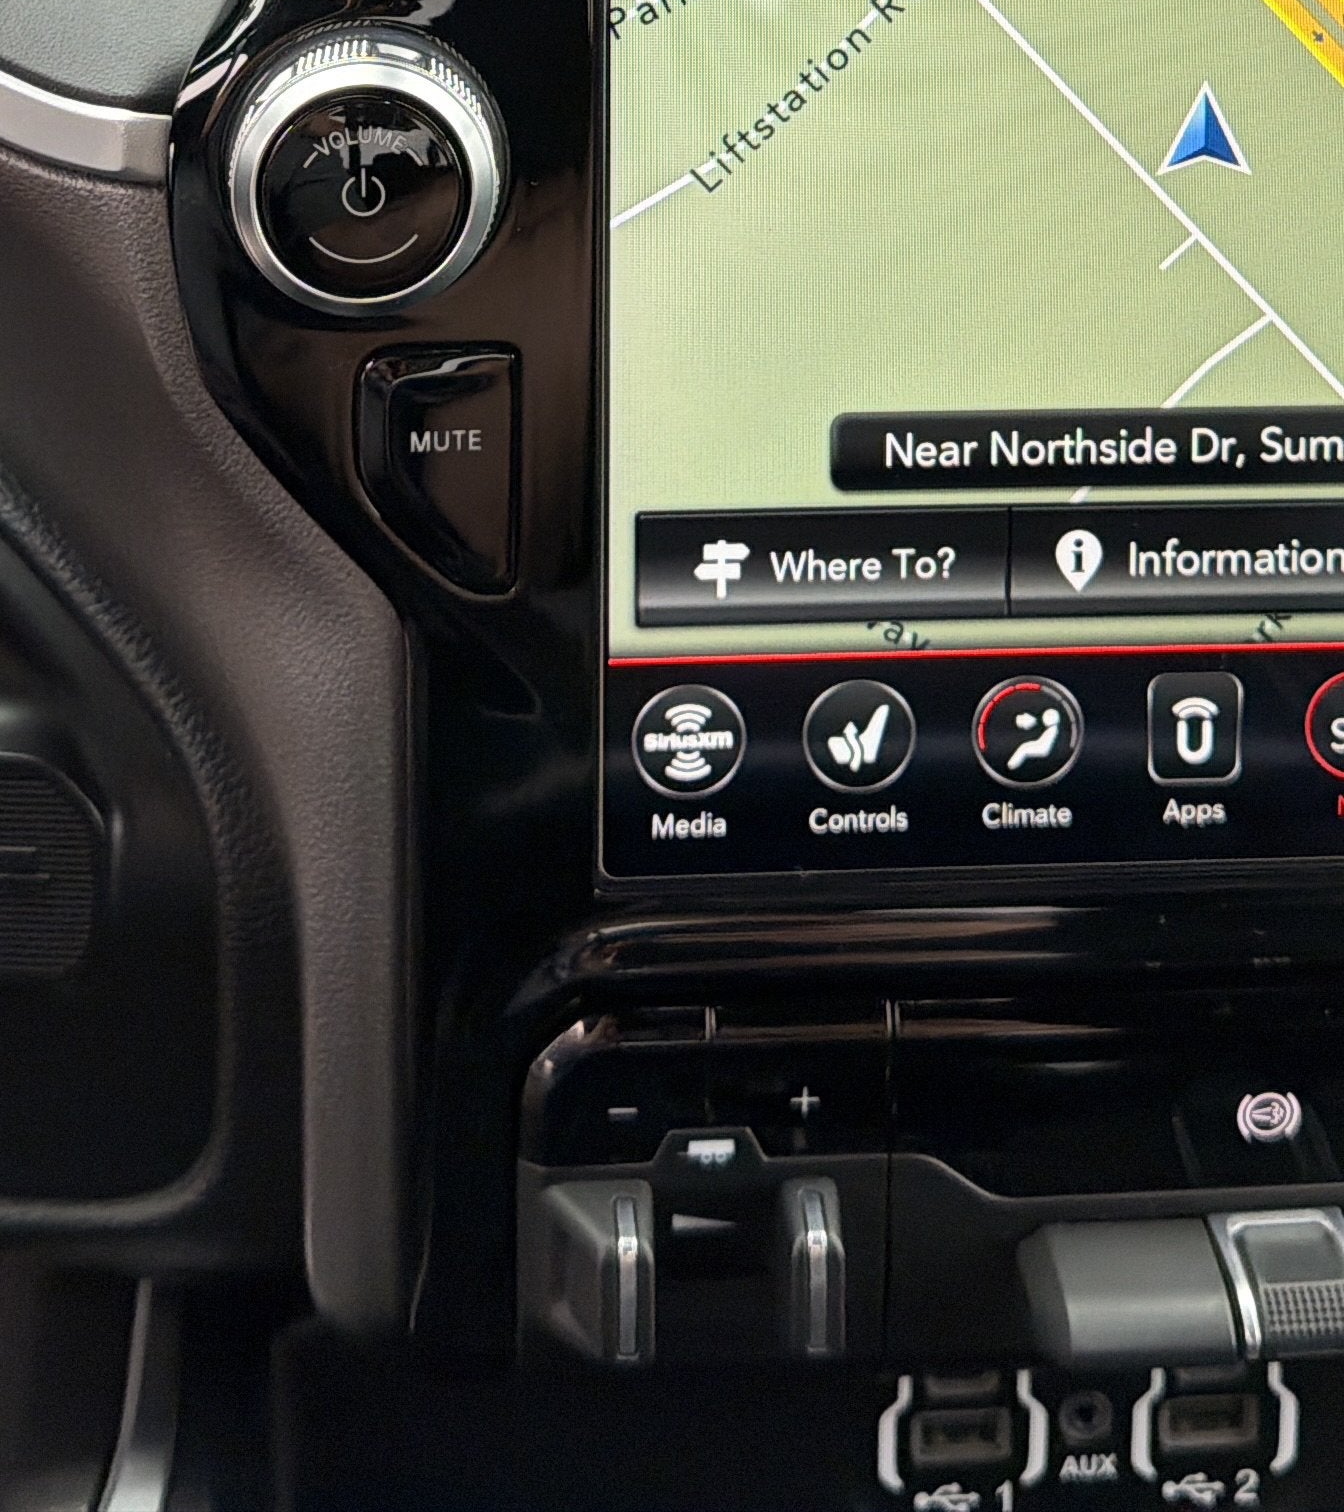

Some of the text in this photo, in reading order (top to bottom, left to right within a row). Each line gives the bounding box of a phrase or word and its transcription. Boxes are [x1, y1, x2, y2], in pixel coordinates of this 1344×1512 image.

[689, 26, 873, 194] Liftstation
[312, 125, 407, 157] VOLUME
[409, 430, 483, 453] MUTE
[884, 433, 978, 469] Near
[990, 427, 1178, 467] Northside
[1191, 428, 1246, 468] Dr,
[770, 546, 957, 584] Where To?
[652, 810, 727, 840] Media
[808, 806, 910, 835] Controls
[981, 800, 1073, 830] Climate
[1163, 798, 1226, 826] Apps
[1059, 1454, 1117, 1481] AUX
[1234, 1468, 1260, 1507] 2
